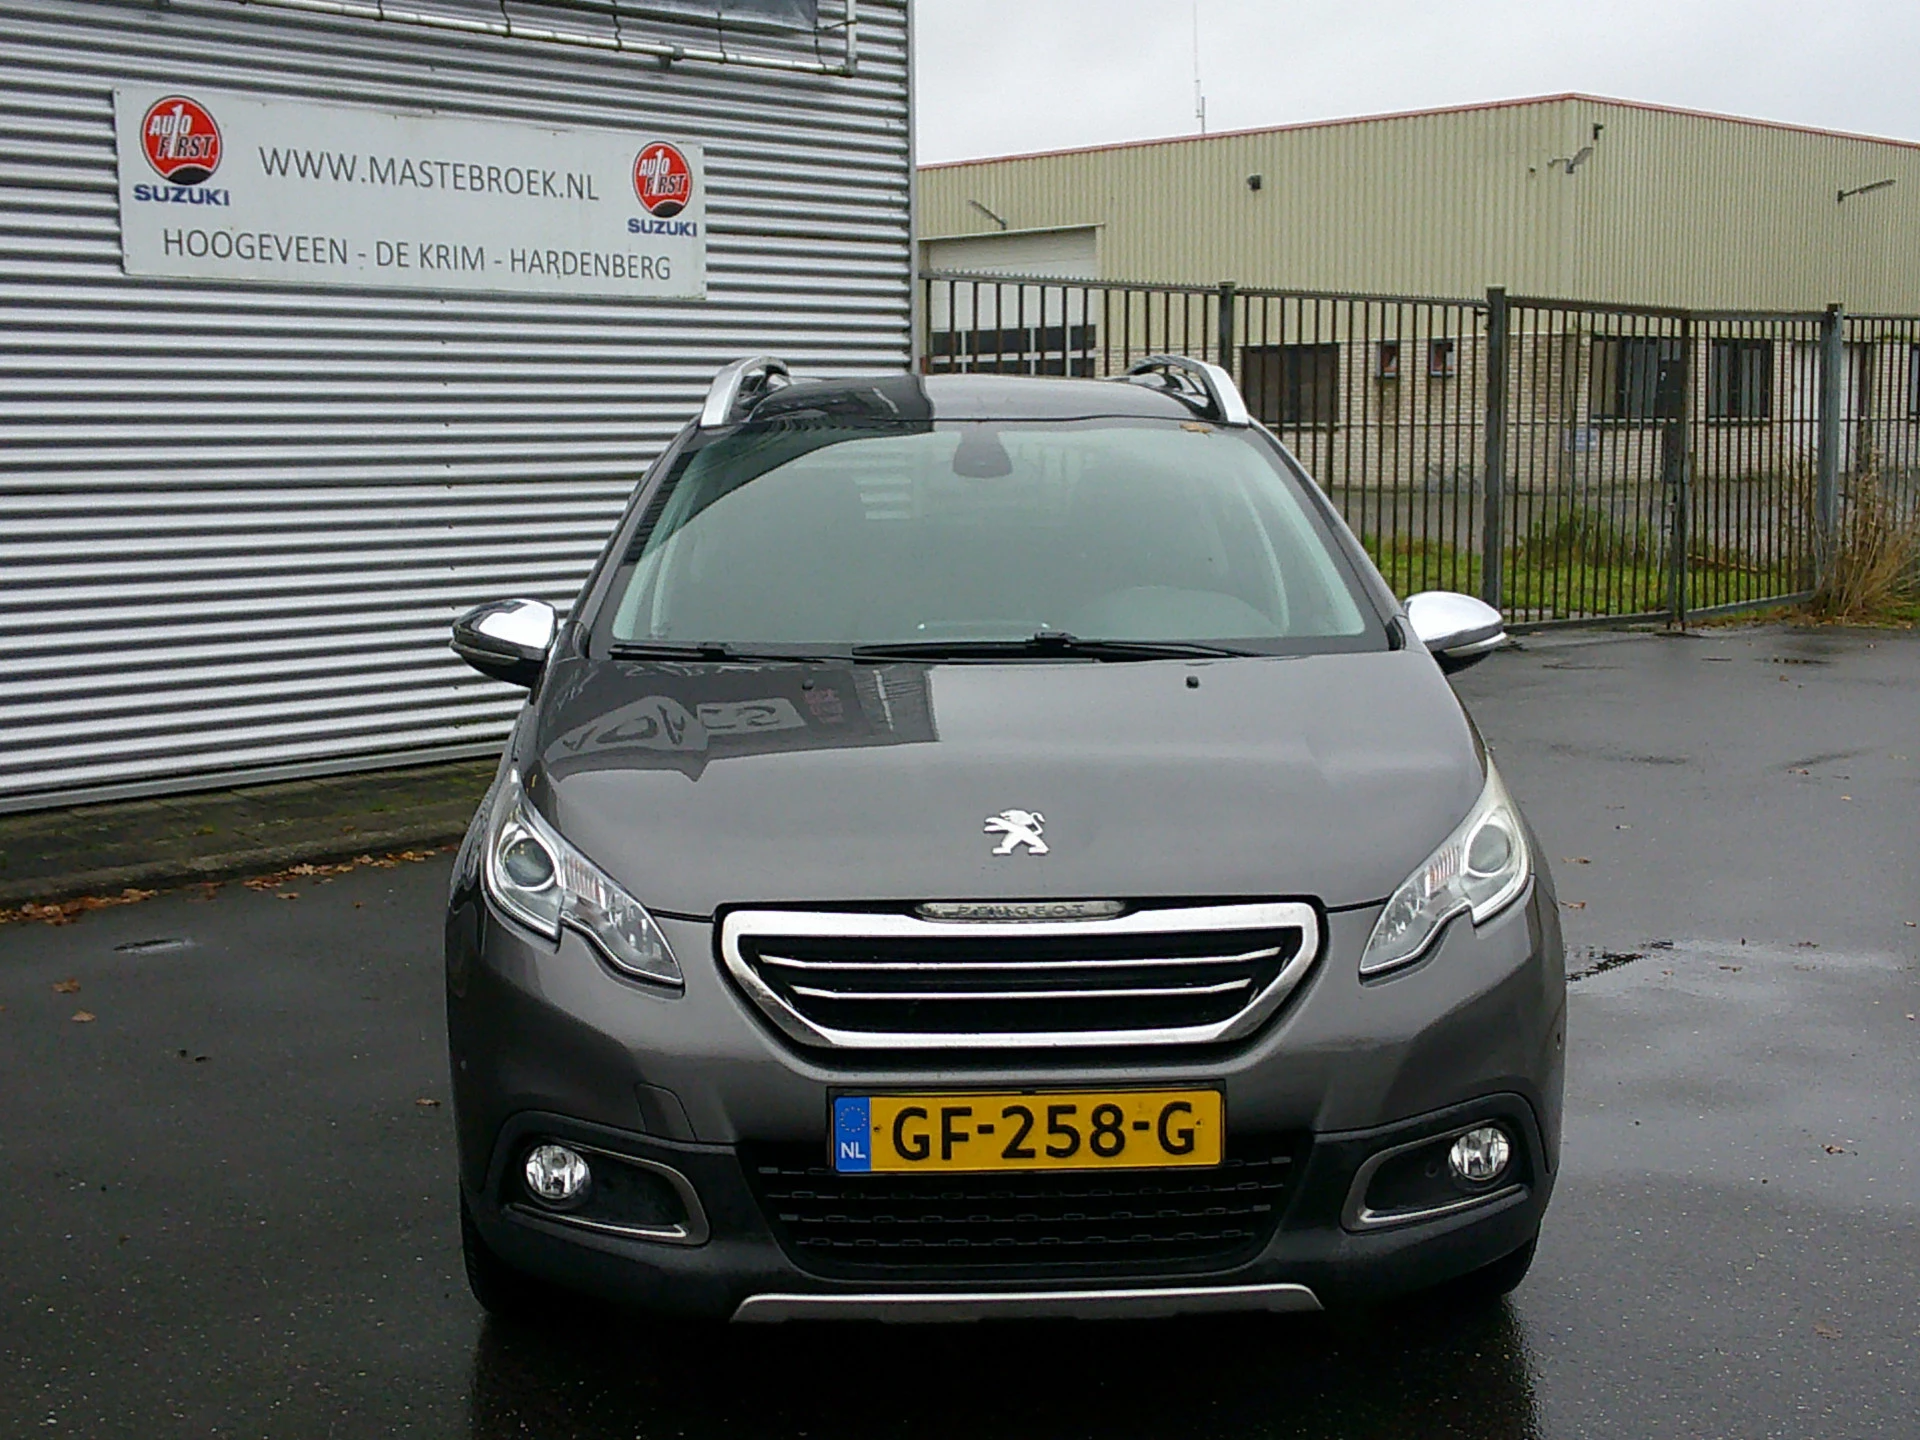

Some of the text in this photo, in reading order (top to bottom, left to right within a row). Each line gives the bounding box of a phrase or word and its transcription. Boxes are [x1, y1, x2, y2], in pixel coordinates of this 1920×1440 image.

[258, 145, 600, 202] WWW.MASTEBROEK.NL
[133, 184, 231, 206] SUZUKI
[627, 218, 698, 237] SUZUKI
[162, 228, 349, 266] HOOGEVEEN
[376, 240, 411, 269] DE
[419, 242, 486, 272] KRIM
[509, 248, 672, 281] HARDENBERG
[891, 1101, 1196, 1162] GF-258-G
[840, 1142, 867, 1160] NL
